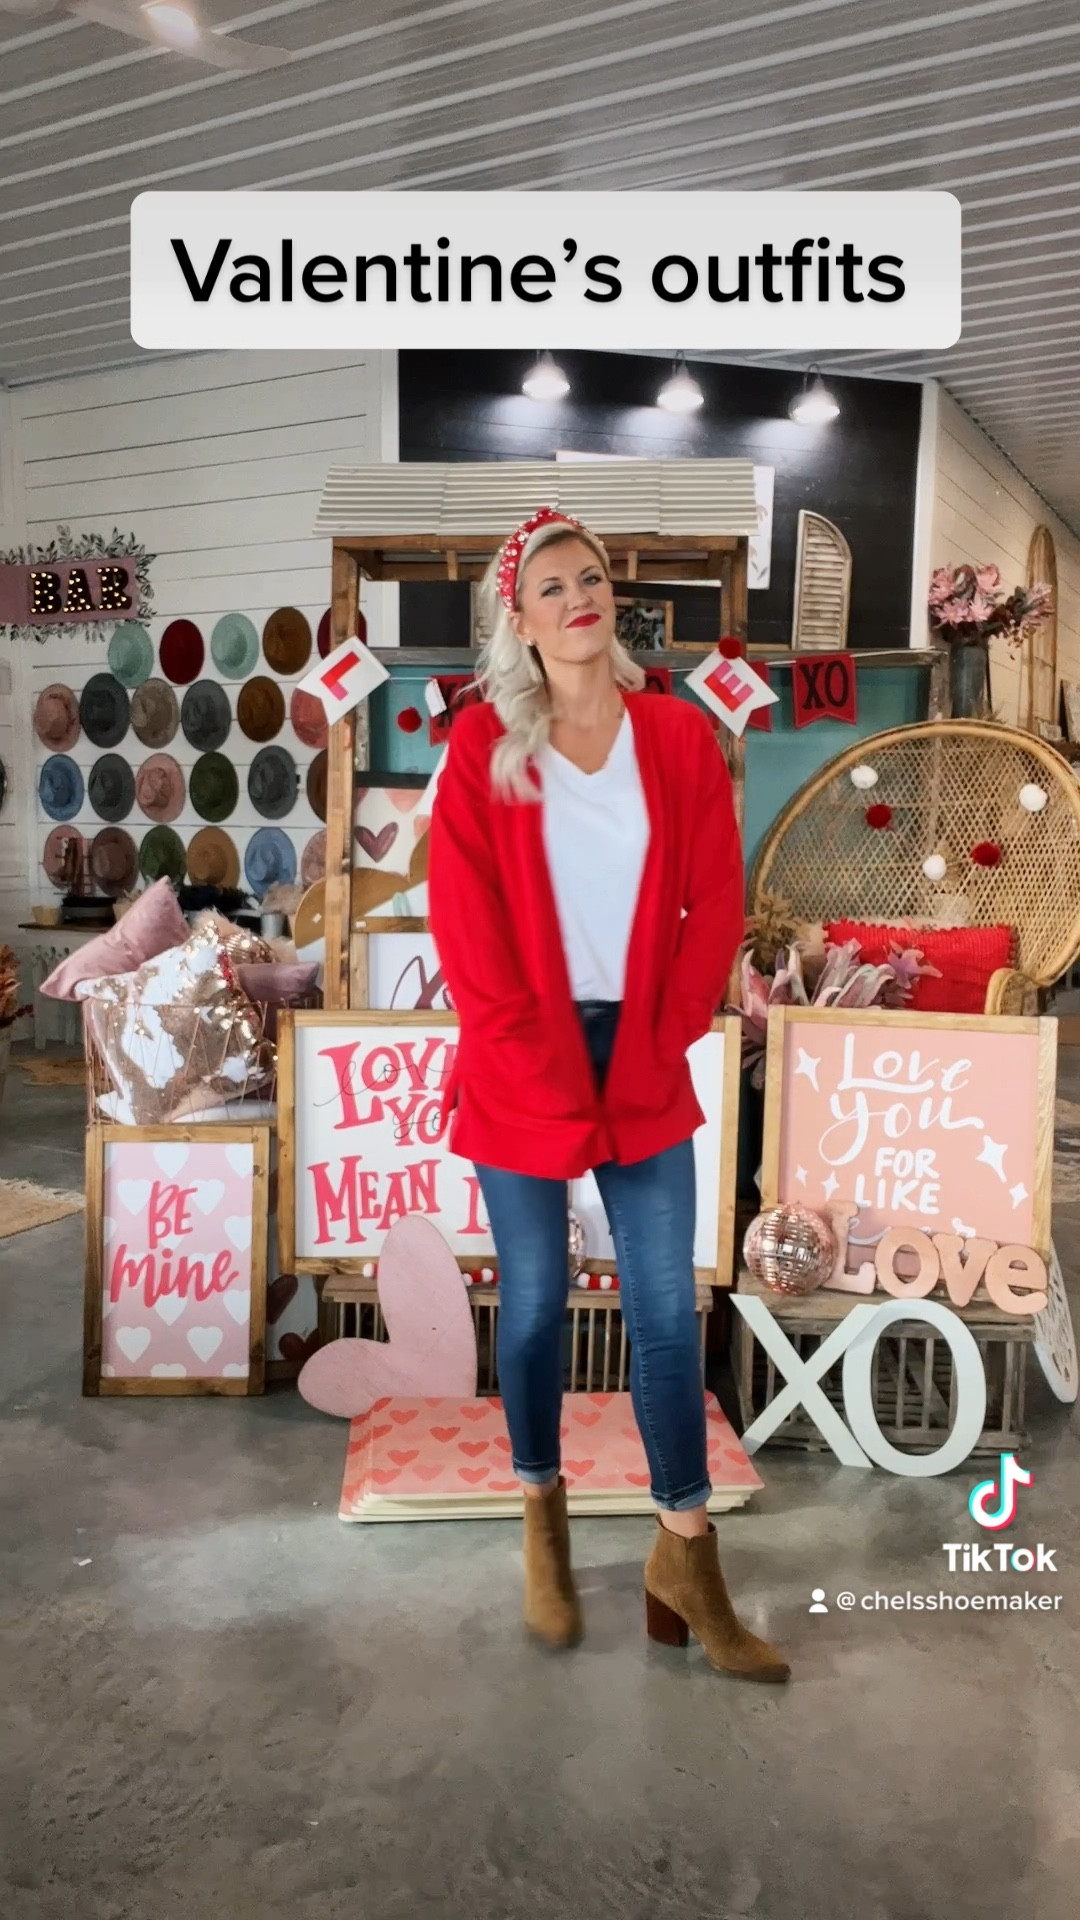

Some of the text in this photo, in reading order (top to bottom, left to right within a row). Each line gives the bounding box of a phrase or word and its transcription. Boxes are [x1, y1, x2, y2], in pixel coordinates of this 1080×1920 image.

[29, 565, 133, 615] BAR
[799, 659, 850, 710] XO
[837, 1032, 972, 1094] Love
[383, 1092, 458, 1147] YO
[874, 1147, 940, 1180] FOR
[147, 1180, 198, 1250] BE
[307, 1155, 442, 1245] MEAN
[855, 1173, 941, 1215] LIKE
[729, 1292, 987, 1478] XO
